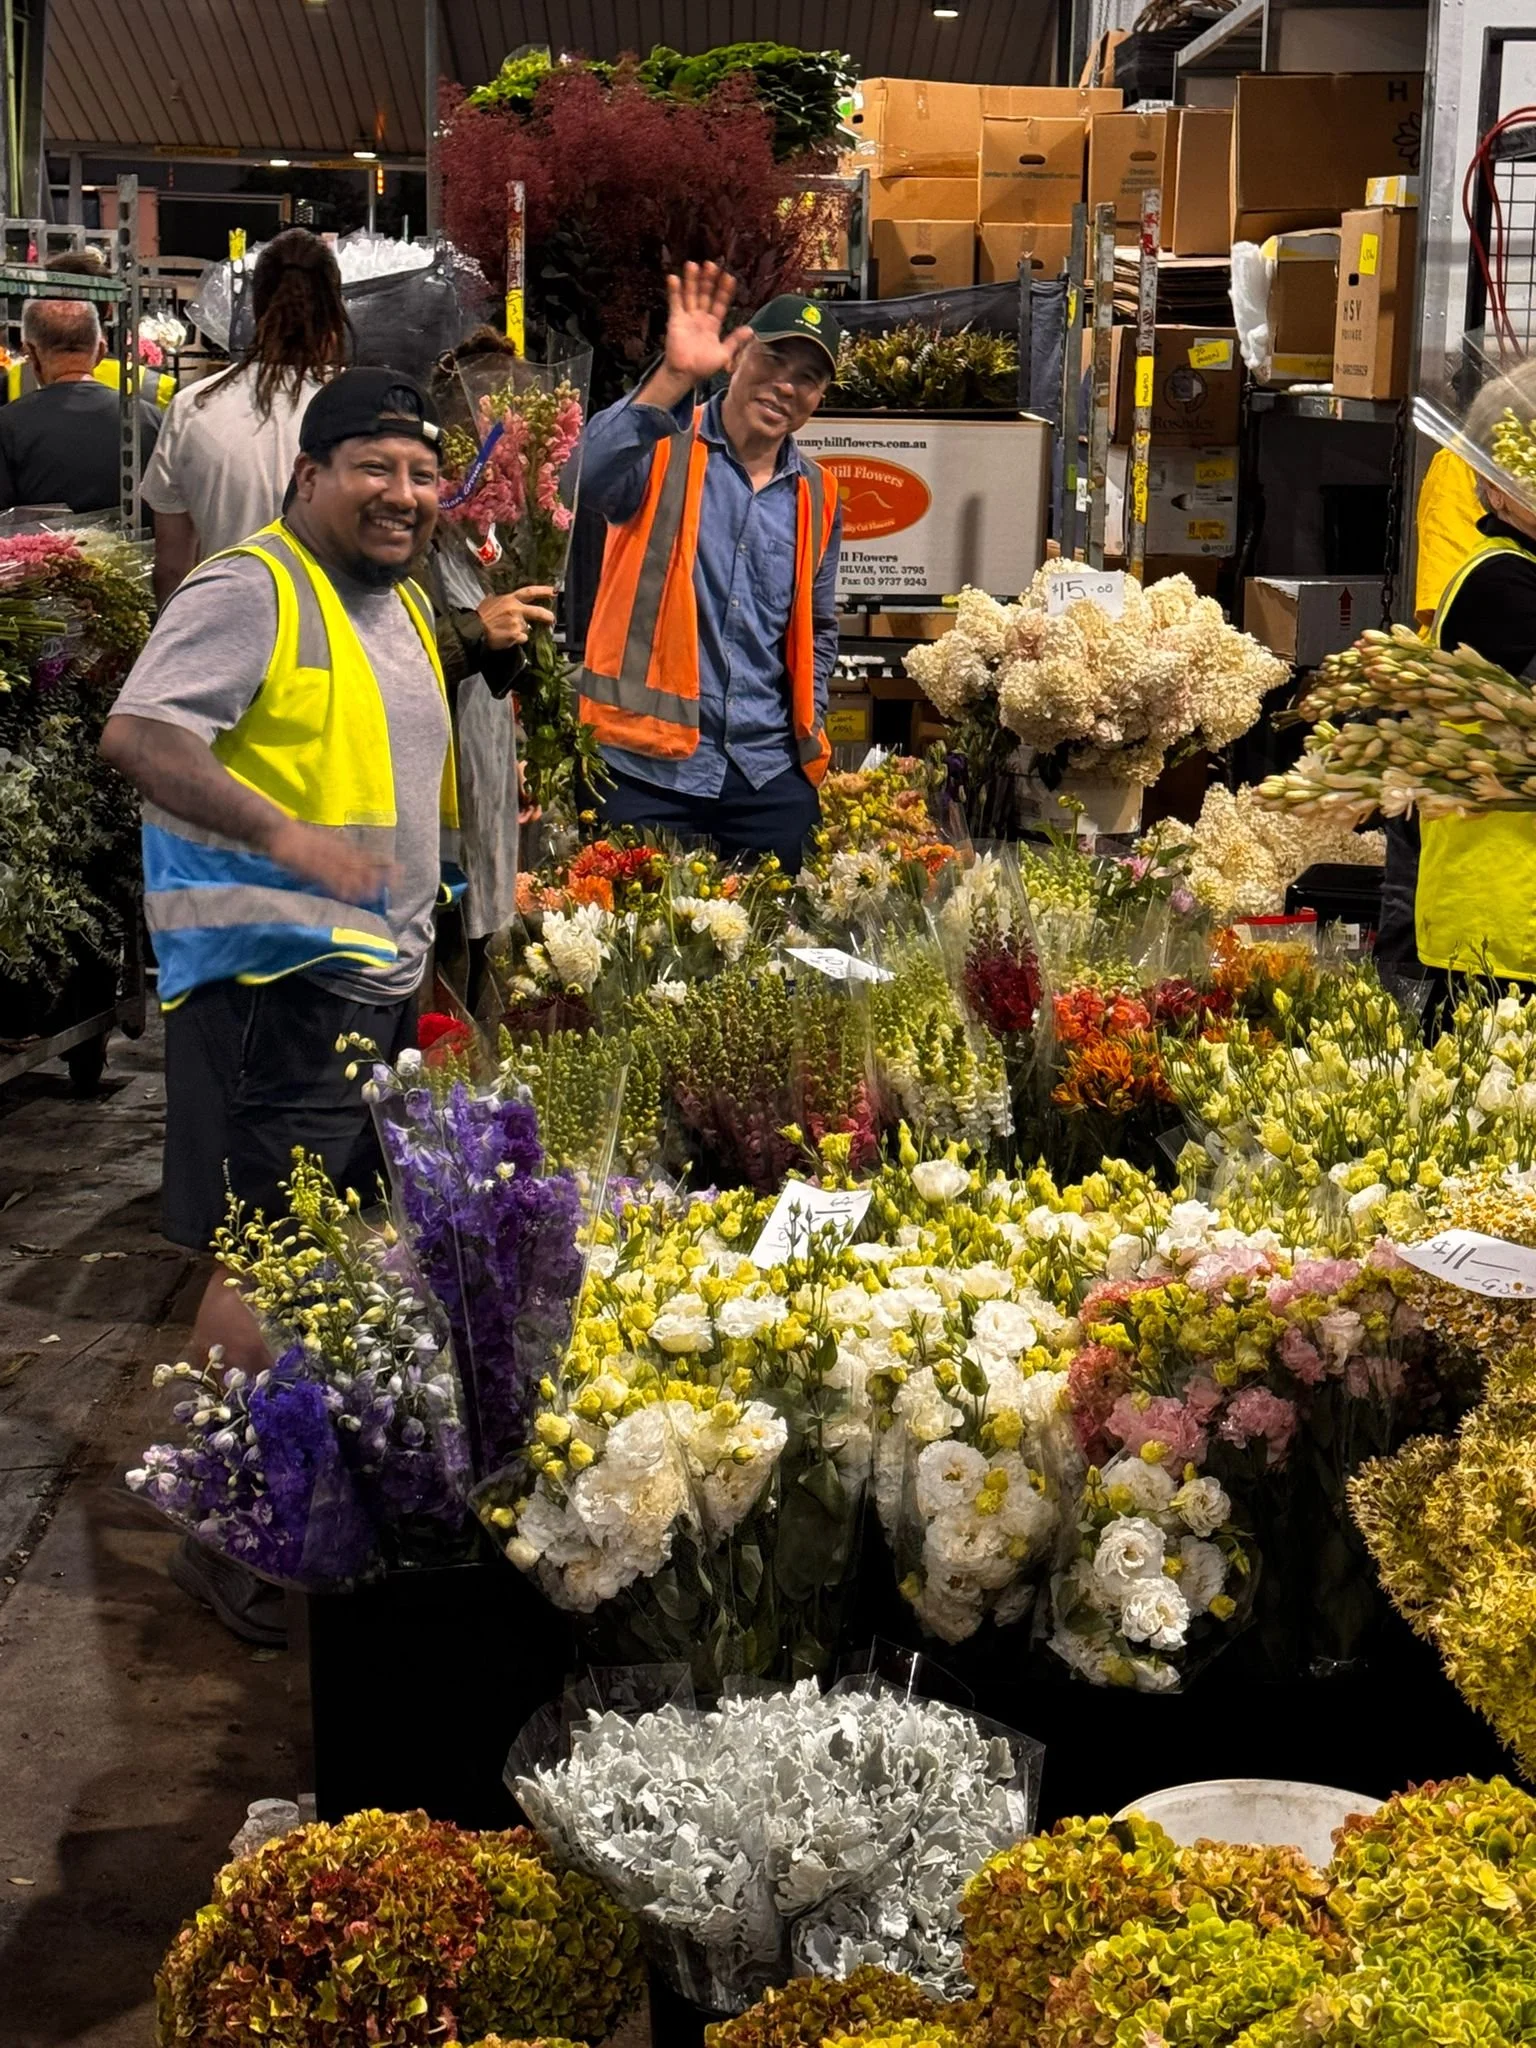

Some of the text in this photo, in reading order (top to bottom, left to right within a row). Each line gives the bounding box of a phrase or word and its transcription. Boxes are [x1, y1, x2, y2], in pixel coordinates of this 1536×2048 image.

[797, 436, 927, 450] unnyhillflowers.com.au
[463, 462, 483, 495] Grown
[854, 466, 904, 488] Flowers
[852, 552, 898, 562] Flowers
[840, 566, 925, 575] SILVAN, VIC. 3795
[841, 577, 927, 586] Fax: 03 9737 9243
